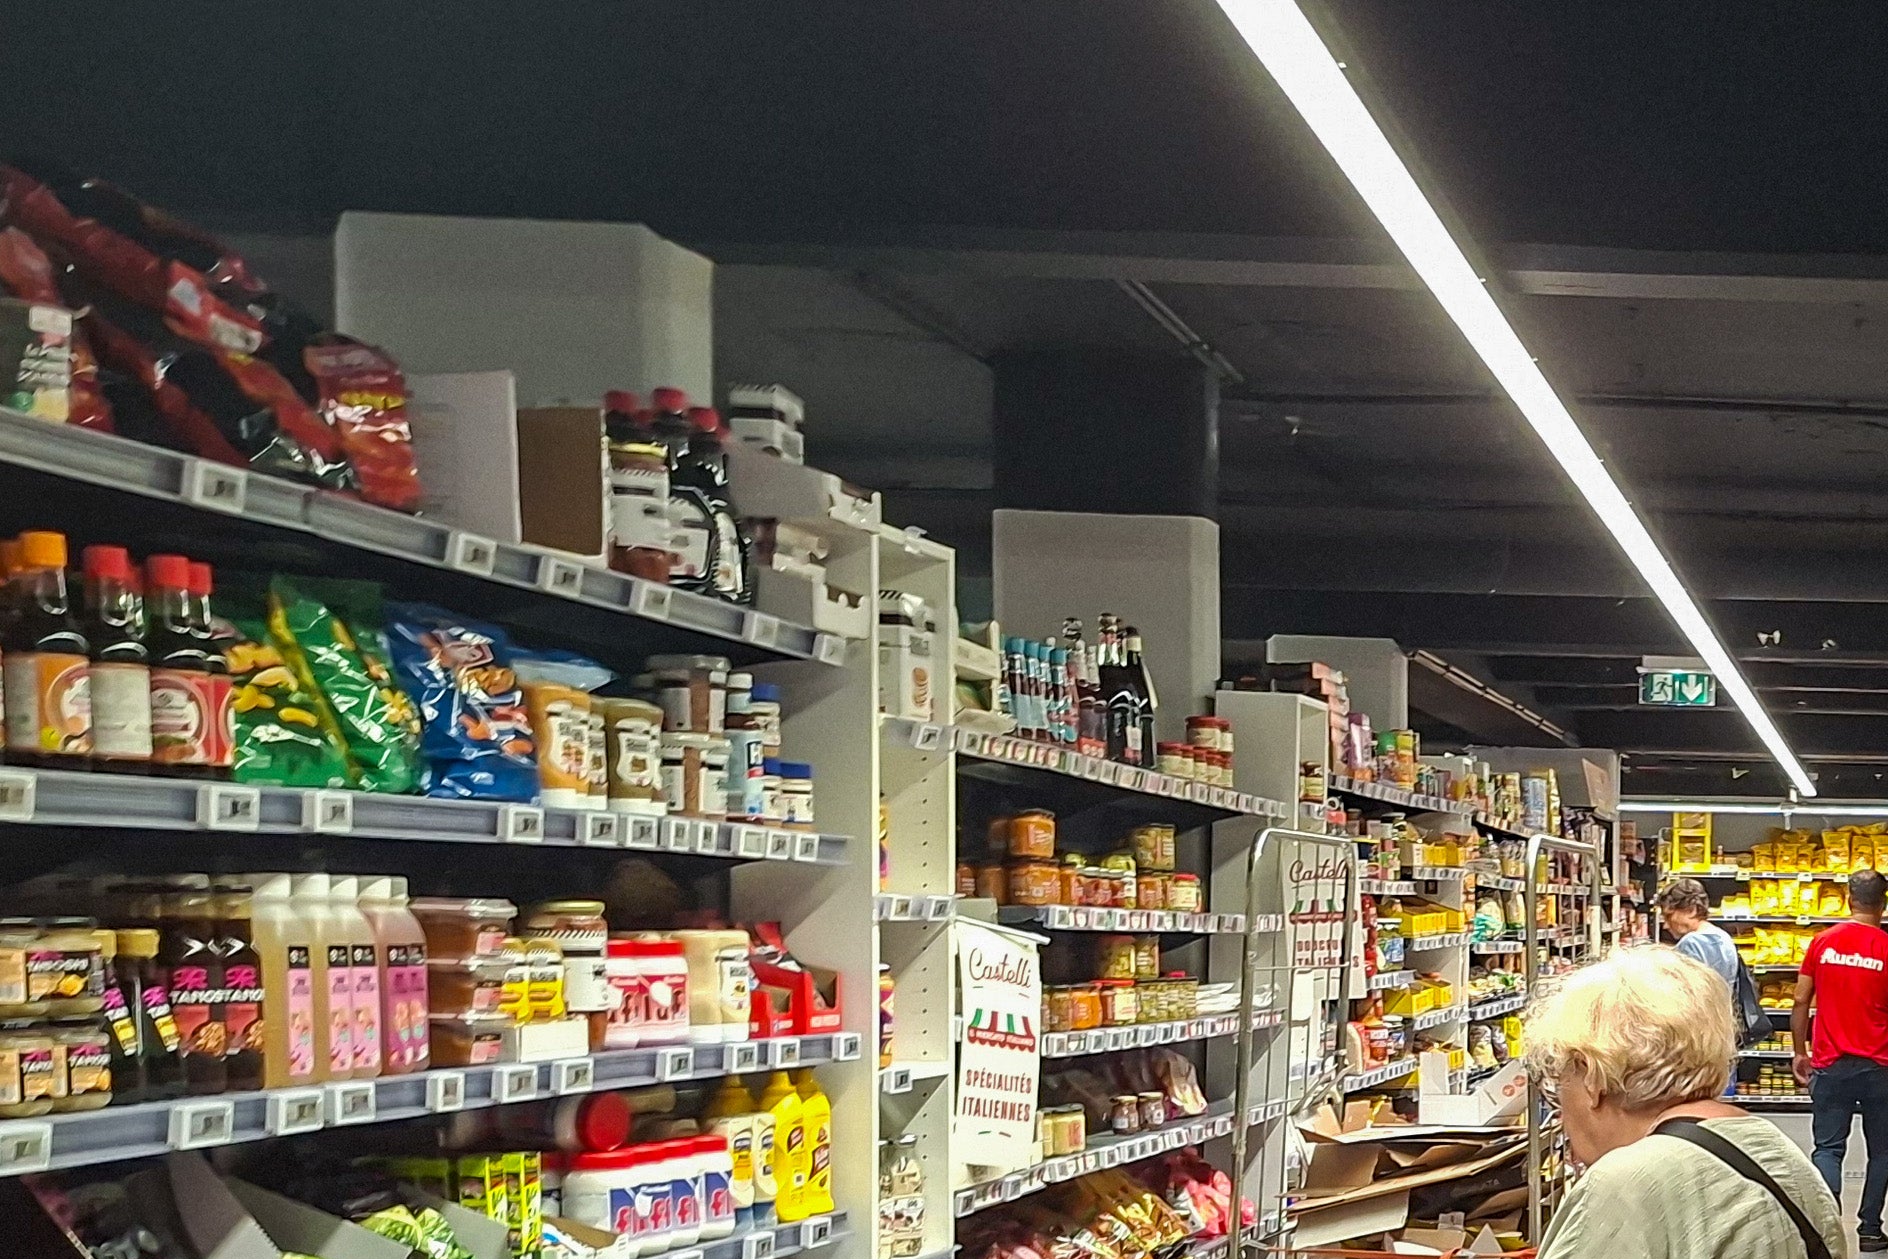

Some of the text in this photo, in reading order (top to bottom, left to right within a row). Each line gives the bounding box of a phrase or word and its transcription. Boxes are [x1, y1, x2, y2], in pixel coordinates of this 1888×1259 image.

[969, 947, 1032, 989] Castelli
[1820, 947, 1884, 972] Auchan
[965, 1067, 1032, 1094] SPÉCIALITÉS
[962, 1096, 1031, 1122] ITALIENNES
